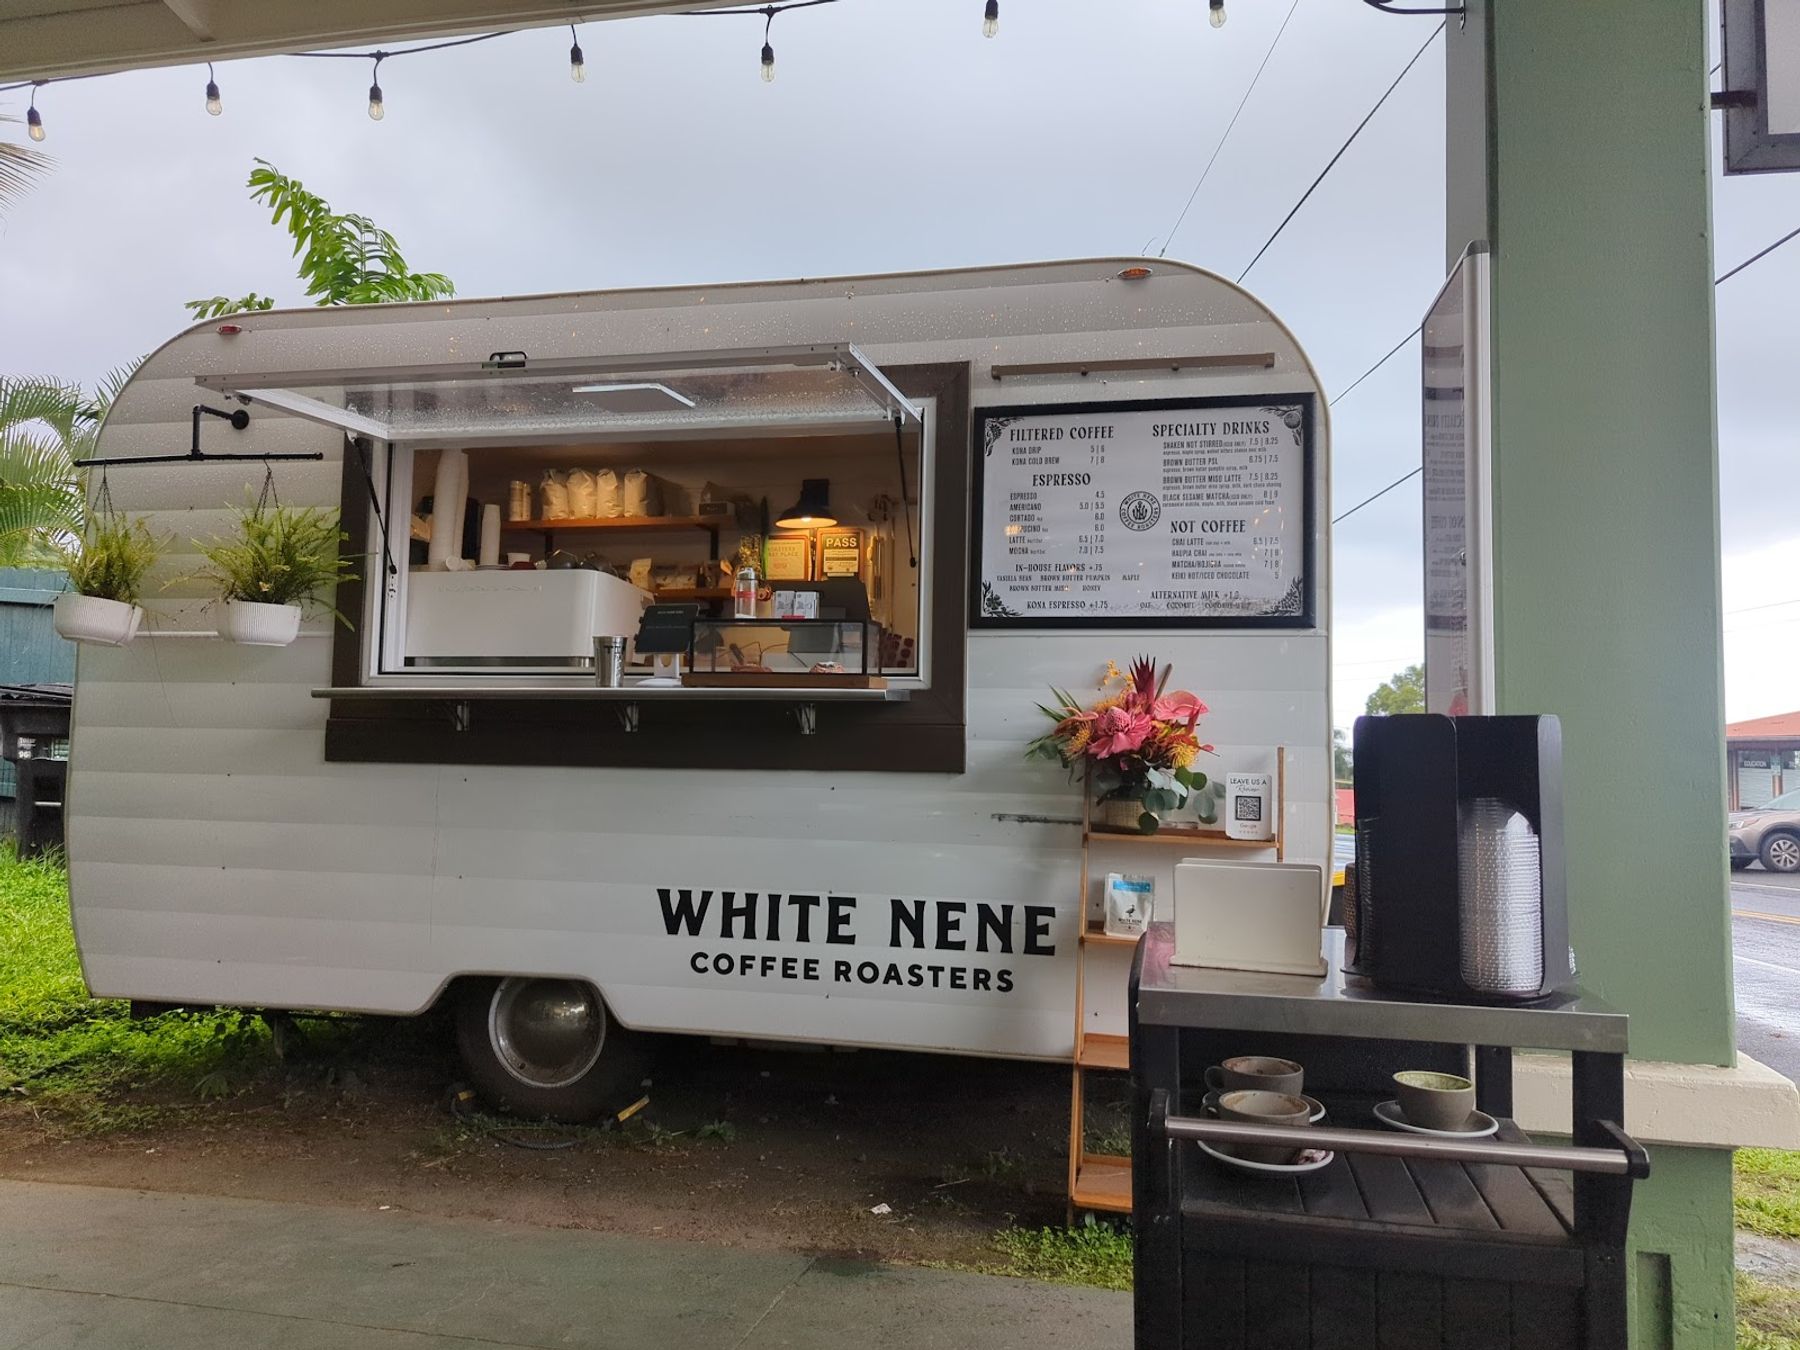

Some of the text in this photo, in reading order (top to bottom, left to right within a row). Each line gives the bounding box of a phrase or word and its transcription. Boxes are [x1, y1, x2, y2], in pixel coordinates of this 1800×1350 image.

[1152, 420, 1269, 436] SPECIALTY DRINKS
[1010, 426, 1114, 441] FILTERED COFFEE
[1269, 454, 1278, 462] 7.5
[1032, 473, 1091, 486] ESPRESSO
[1224, 474, 1241, 482] LATTE
[1010, 492, 1037, 500] ESPRESSO
[1010, 503, 1042, 511] AMERICANO
[1170, 520, 1246, 533] NOT COFFEE
[826, 538, 857, 548] PASS
[1010, 536, 1025, 544] LATTE
[1172, 572, 1186, 580] KEIKI
[1216, 572, 1249, 580] CHOCOLATE
[1151, 590, 1198, 600] ALTERNATIVE
[1027, 601, 1046, 609] KONA
[1050, 601, 1086, 609] ESPRESSO
[656, 888, 1057, 956] WHITE NENE
[690, 952, 1014, 993] COFFEE ROASTERS
